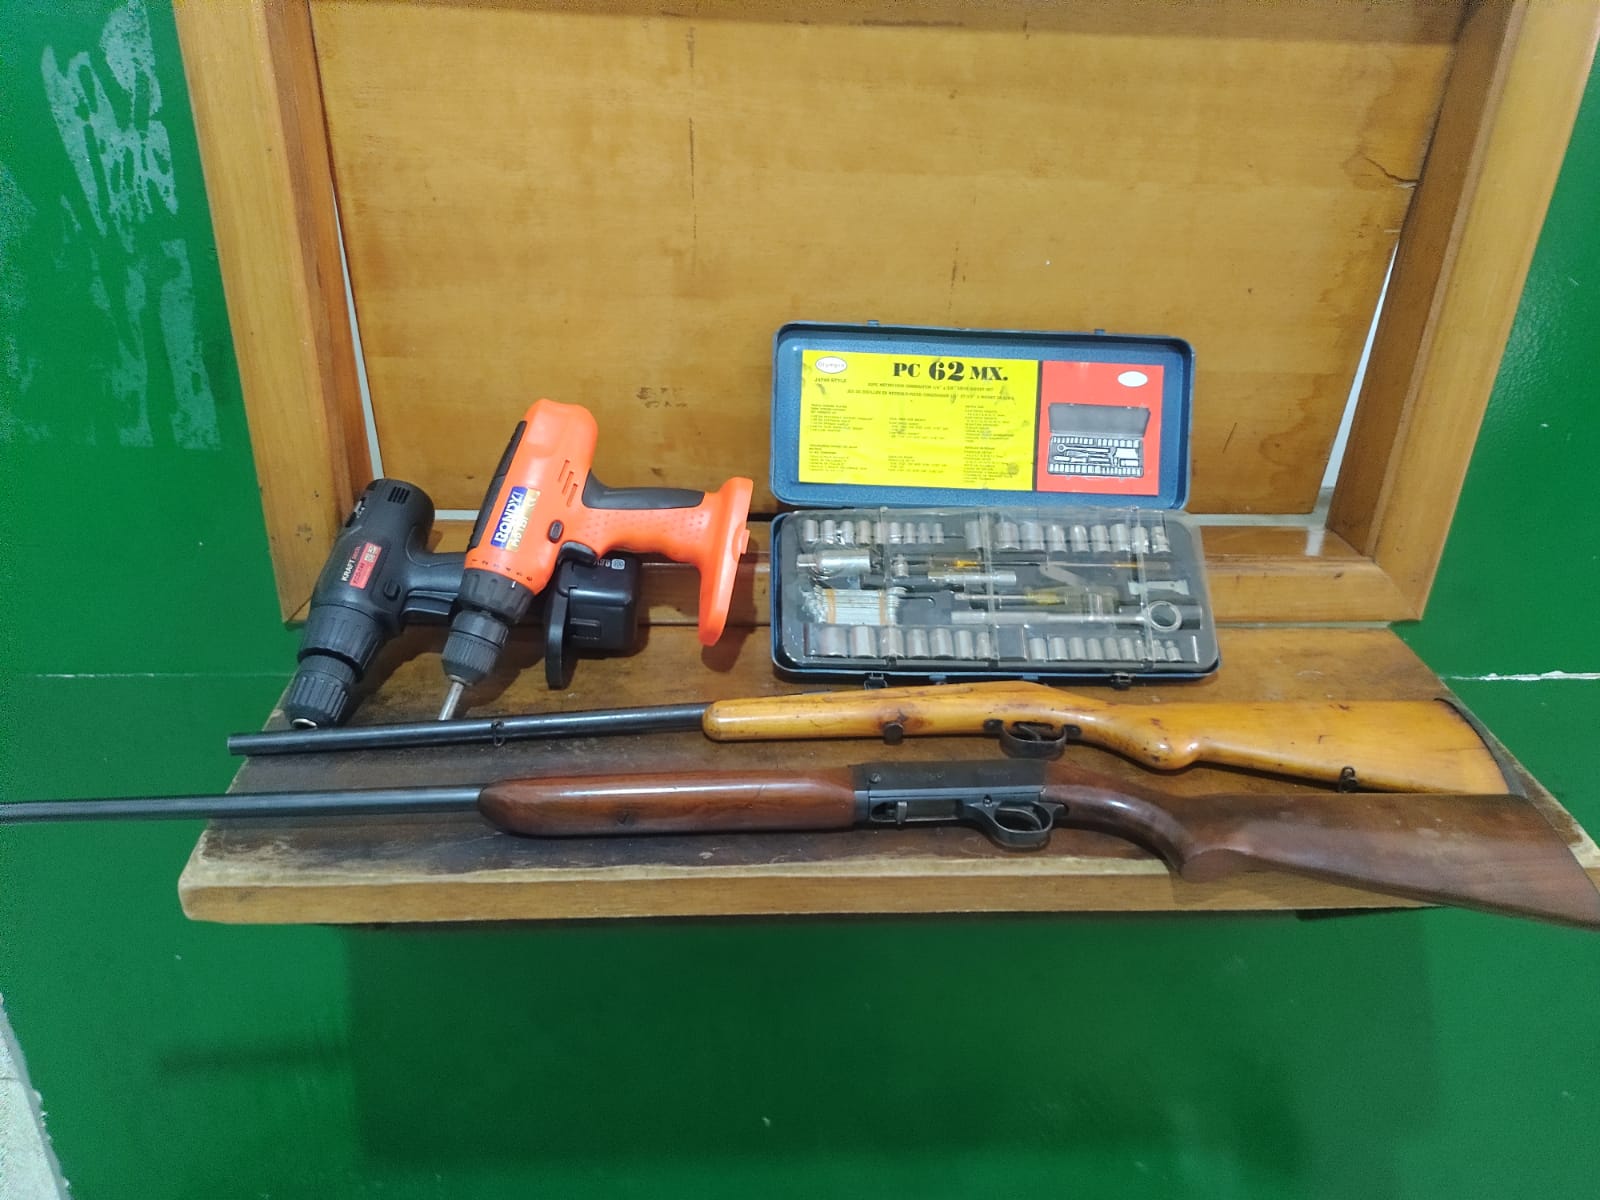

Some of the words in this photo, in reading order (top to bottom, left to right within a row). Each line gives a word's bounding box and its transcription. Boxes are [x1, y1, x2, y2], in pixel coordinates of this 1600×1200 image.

[893, 362, 921, 377] PC
[928, 361, 964, 381] 62
[970, 366, 1009, 381] MX.
[341, 559, 356, 582] KRAFT
